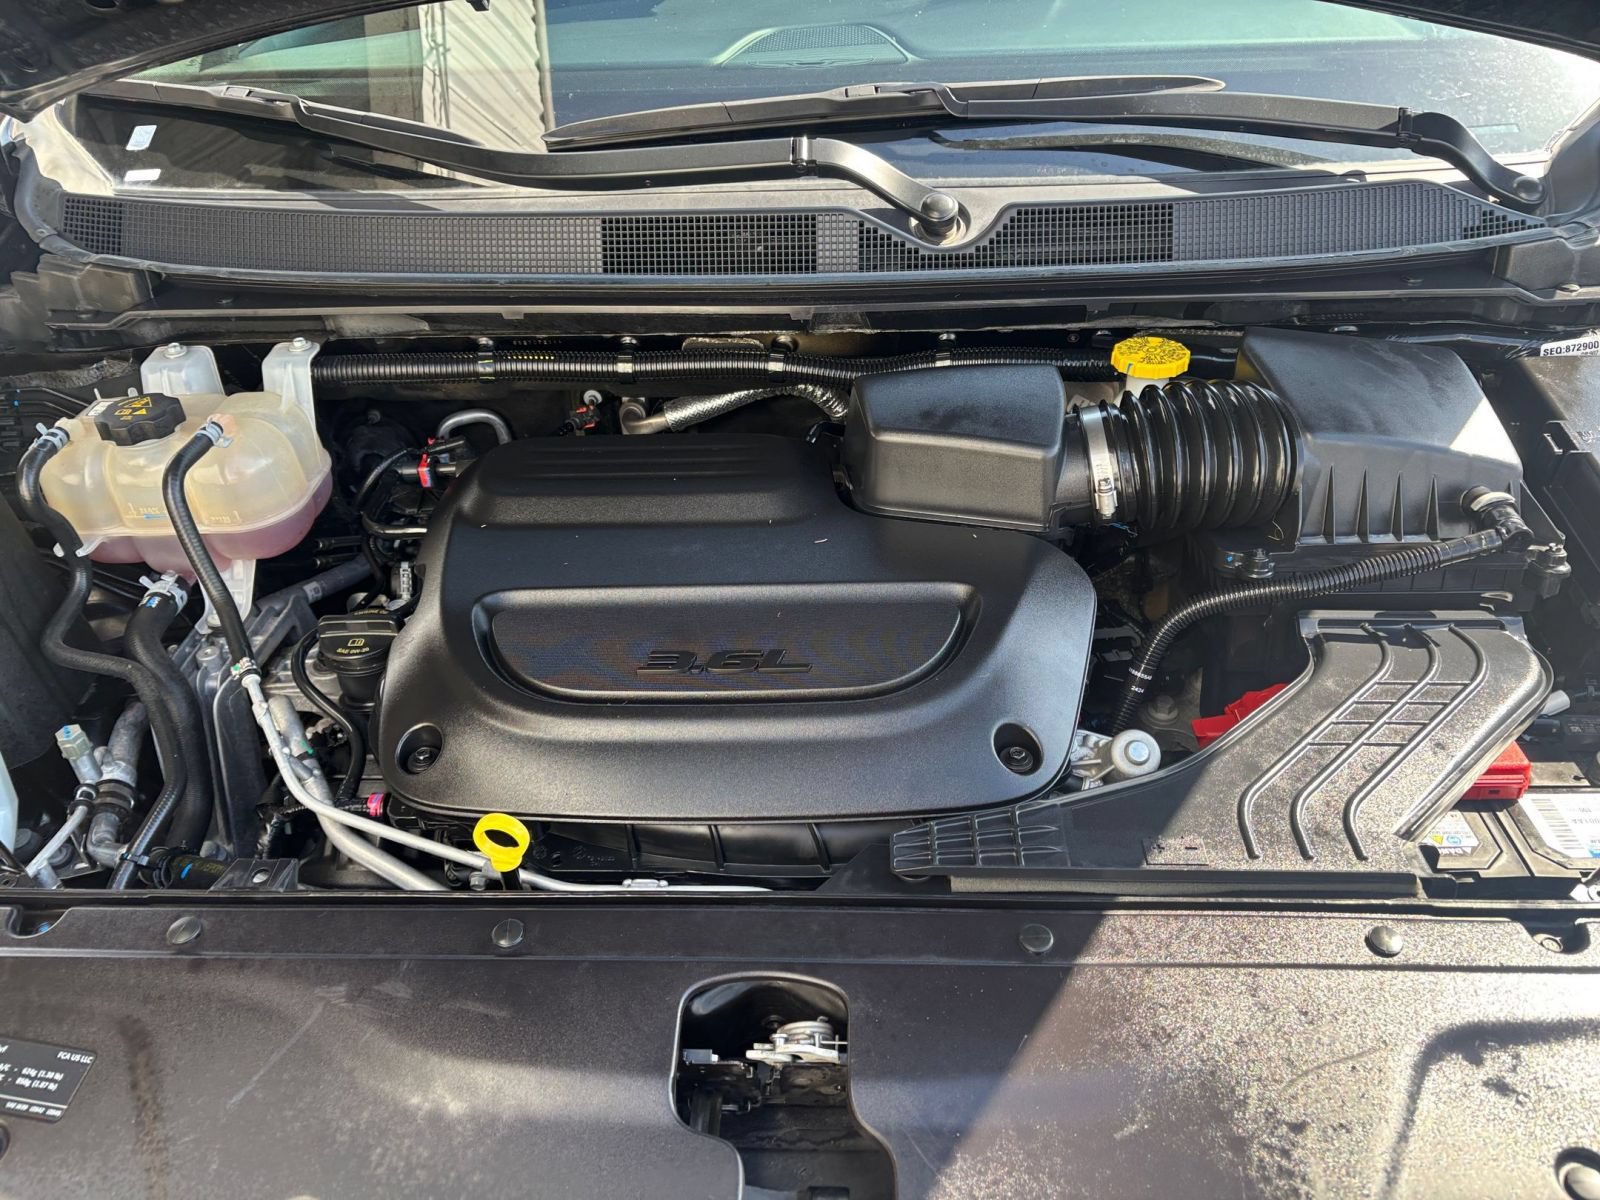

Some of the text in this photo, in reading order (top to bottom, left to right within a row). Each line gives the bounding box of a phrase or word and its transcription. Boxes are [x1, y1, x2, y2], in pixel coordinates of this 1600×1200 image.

[1543, 341, 1599, 356] SEQ:872900
[637, 649, 813, 674] 3.6L
[57, 1051, 94, 1064] FCA US LLC
